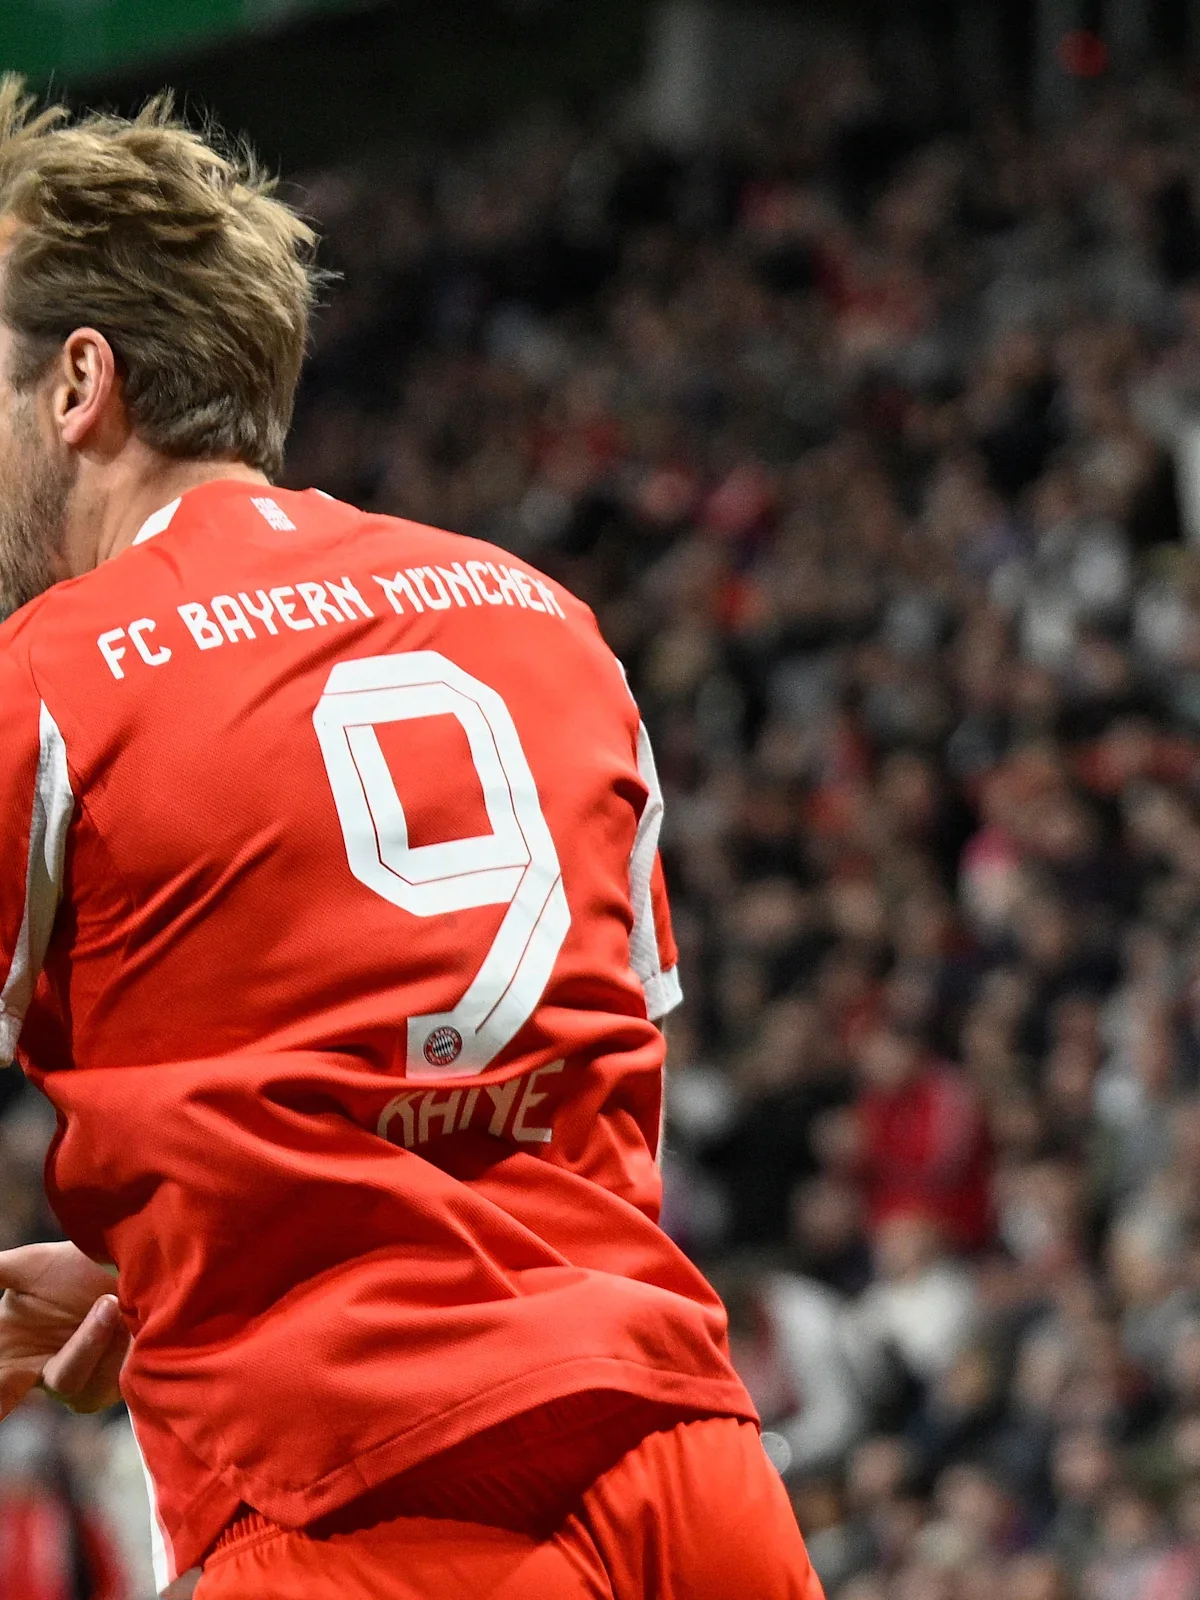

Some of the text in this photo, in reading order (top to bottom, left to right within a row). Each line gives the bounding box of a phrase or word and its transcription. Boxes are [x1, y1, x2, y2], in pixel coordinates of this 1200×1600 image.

[97, 560, 567, 680] FC BAYERN MÜNCHEN
[312, 650, 572, 1079] 9
